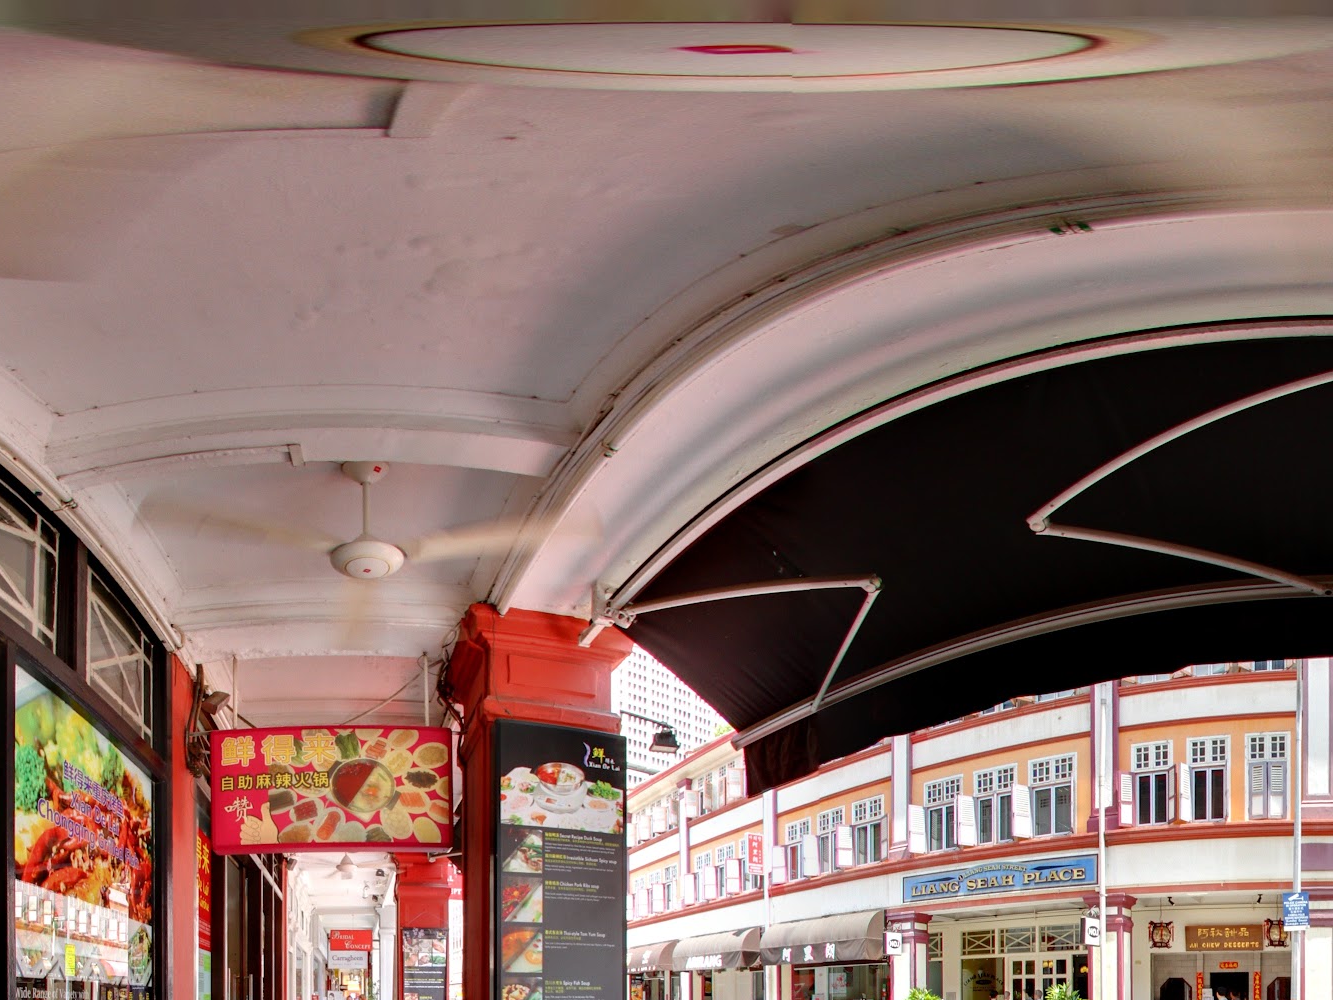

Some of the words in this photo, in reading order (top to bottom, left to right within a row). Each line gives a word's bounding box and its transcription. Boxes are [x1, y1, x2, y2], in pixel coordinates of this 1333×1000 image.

[221, 733, 336, 767] 鲜得来
[221, 772, 329, 791] 自助麻辣火锅
[70, 791, 92, 817] Xian
[94, 805, 106, 827] De
[108, 816, 120, 836] Lai
[37, 798, 95, 850] Chongqing
[98, 833, 124, 861] Grilled
[911, 881, 960, 897] LIANG
[966, 874, 1015, 890] SEAH
[1023, 868, 1085, 884] PLACE
[1002, 864, 1027, 872] STREET
